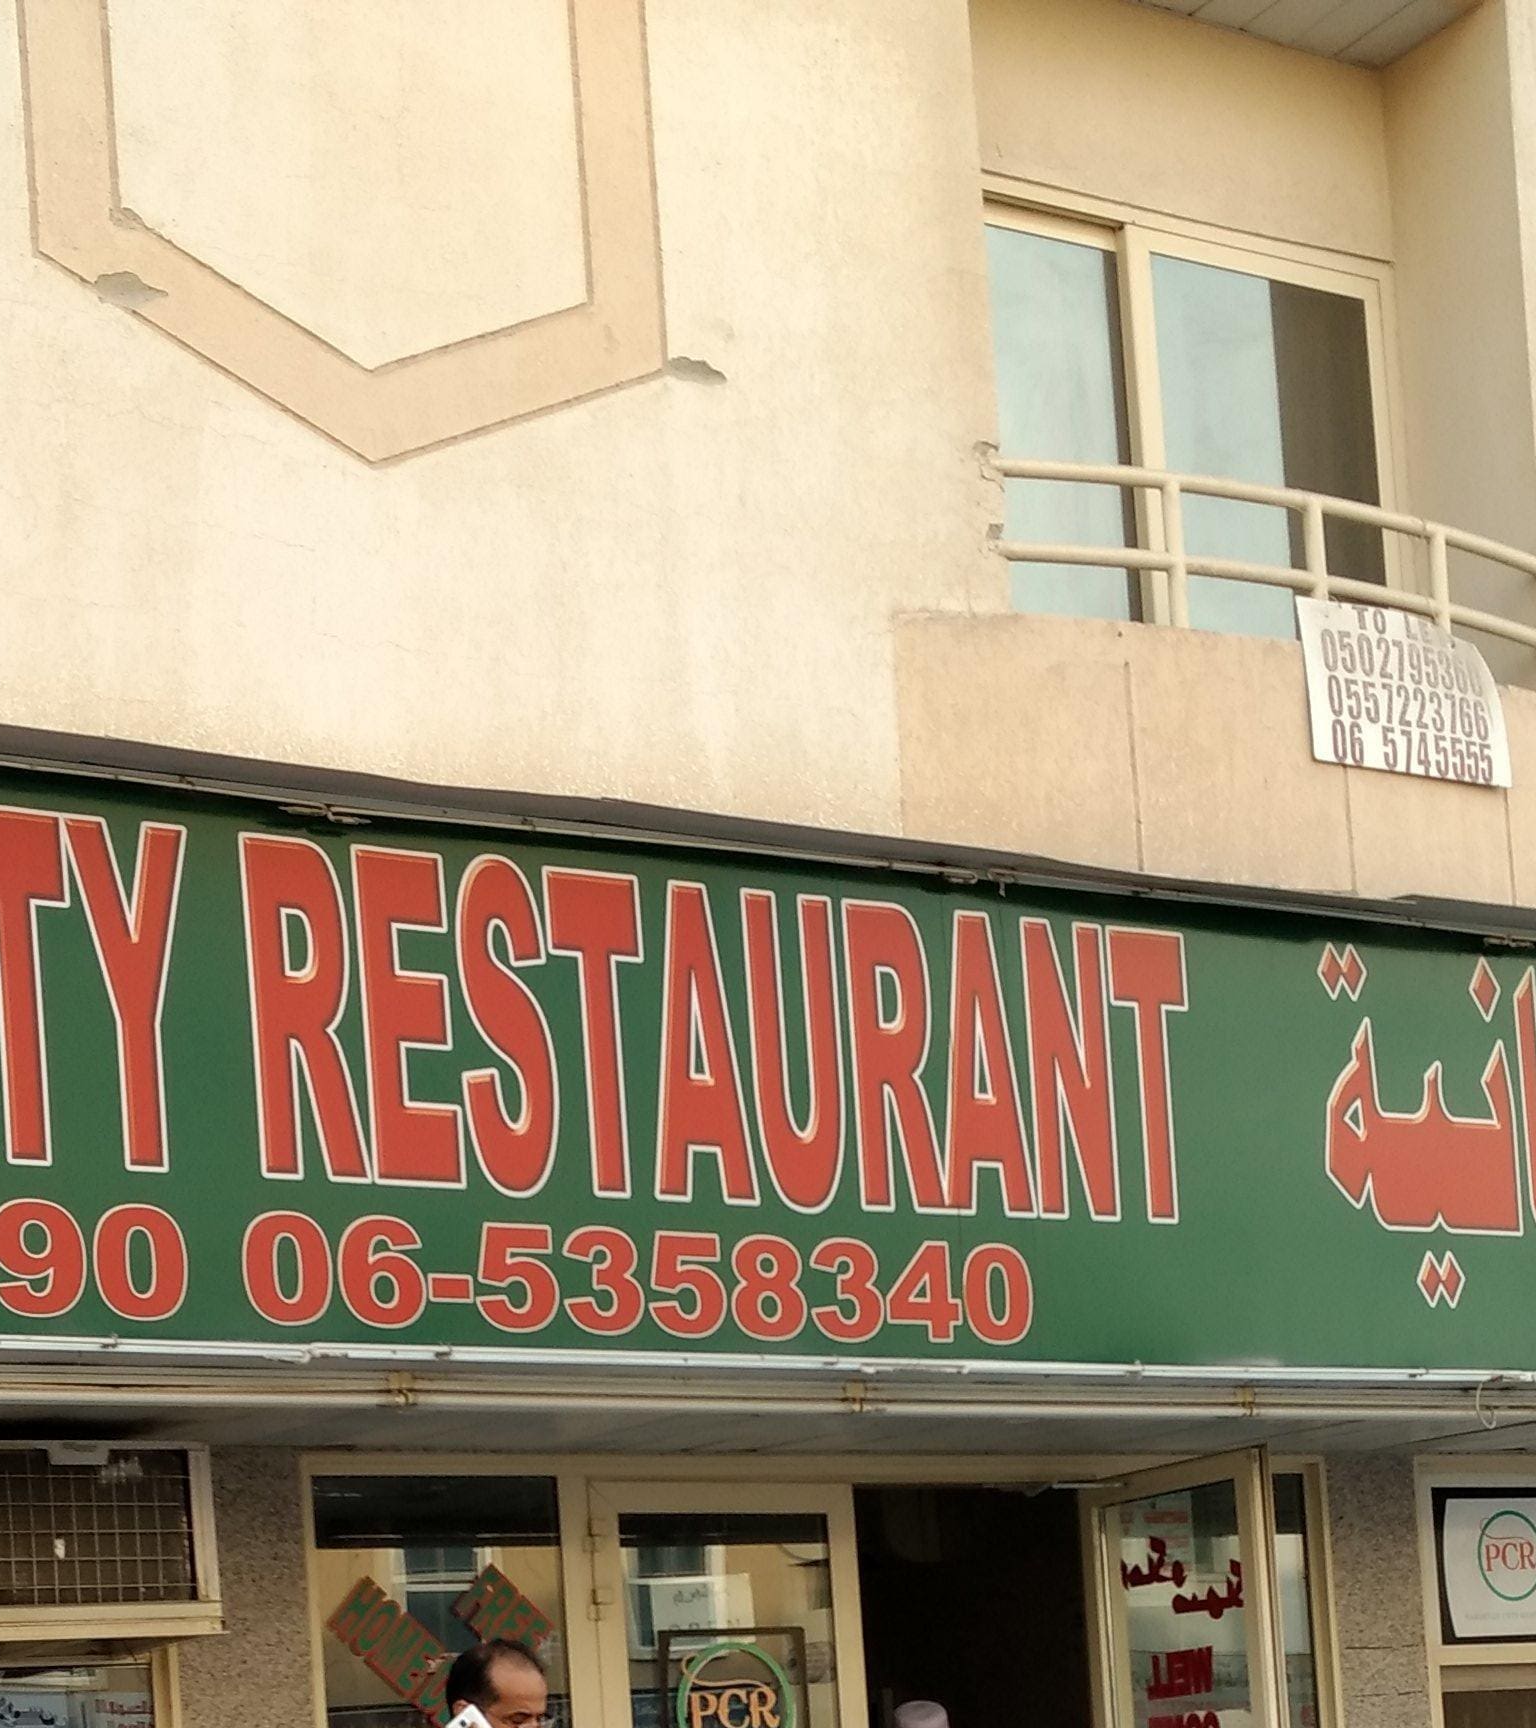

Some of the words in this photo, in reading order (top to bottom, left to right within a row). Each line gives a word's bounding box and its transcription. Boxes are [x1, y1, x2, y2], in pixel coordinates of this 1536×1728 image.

[1352, 606, 1387, 635] TO
[1327, 674, 1490, 742] 0557223766
[1331, 718, 1365, 767] 06
[1381, 725, 1493, 784] 5745555
[235, 830, 1190, 1224] RESTAURANT
[241, 1210, 1034, 1346] 06-5358340
